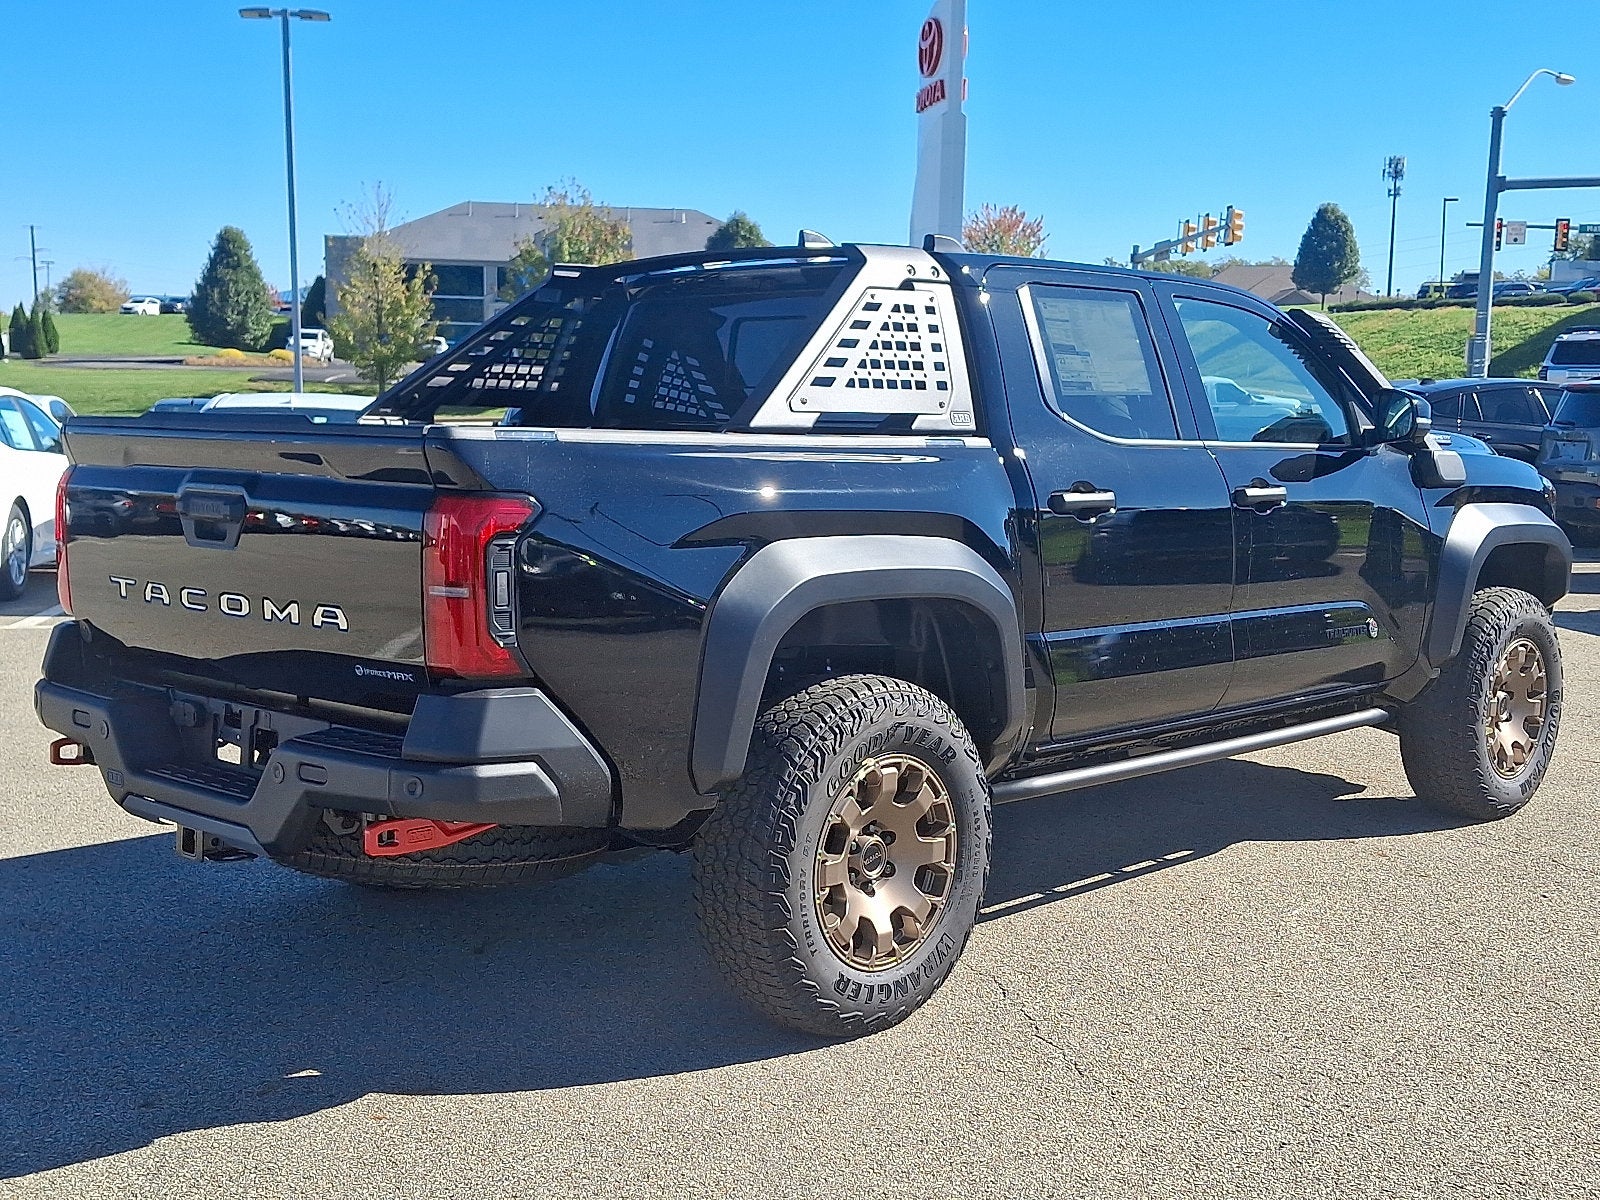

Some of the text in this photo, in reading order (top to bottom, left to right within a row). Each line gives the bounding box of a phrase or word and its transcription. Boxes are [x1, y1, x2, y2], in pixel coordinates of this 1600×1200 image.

[109, 575, 349, 632] TACOMA
[826, 721, 958, 798] GOODYEAR
[799, 867, 819, 958] TERRITORY
[833, 932, 956, 1004] WRANGLER
